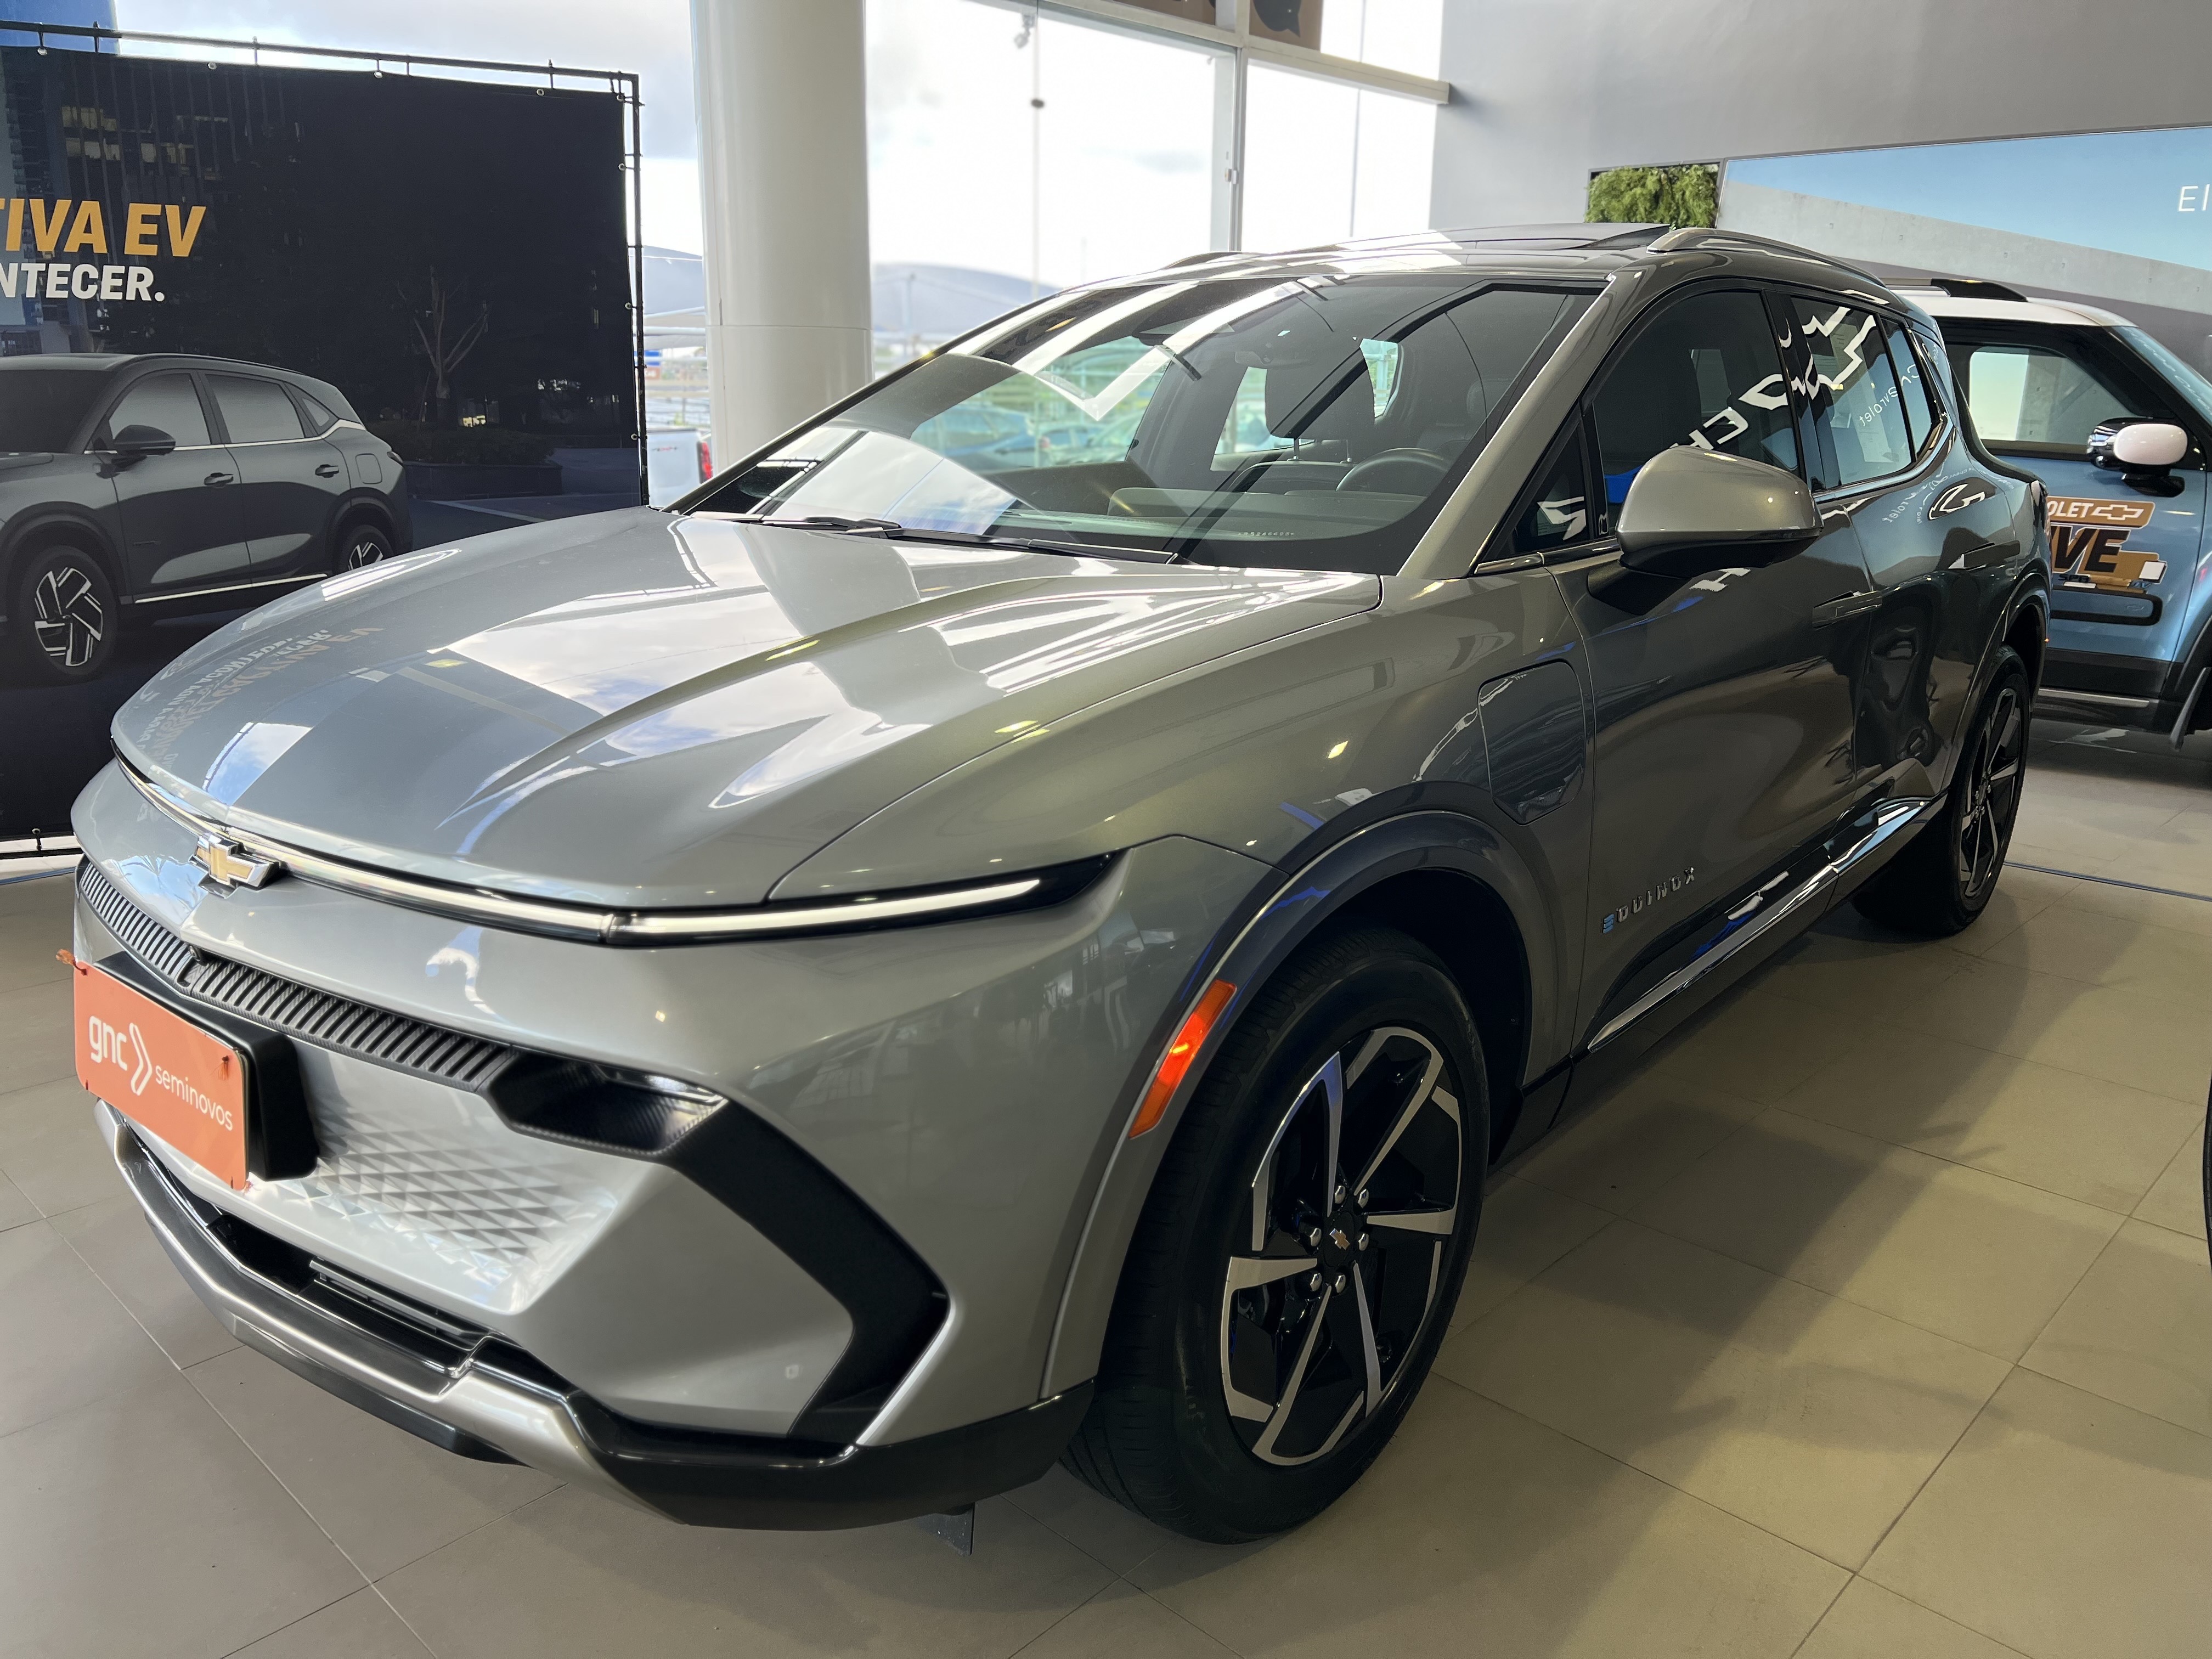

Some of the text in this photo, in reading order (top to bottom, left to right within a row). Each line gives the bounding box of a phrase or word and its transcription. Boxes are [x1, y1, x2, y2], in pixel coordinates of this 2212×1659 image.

[0, 198, 206, 257] IVA EV
[2047, 500, 2094, 518] OLET
[2051, 526, 2131, 573] VE
[1602, 867, 1695, 933] EQUINOX
[88, 1015, 233, 1131] gnc seminovos
